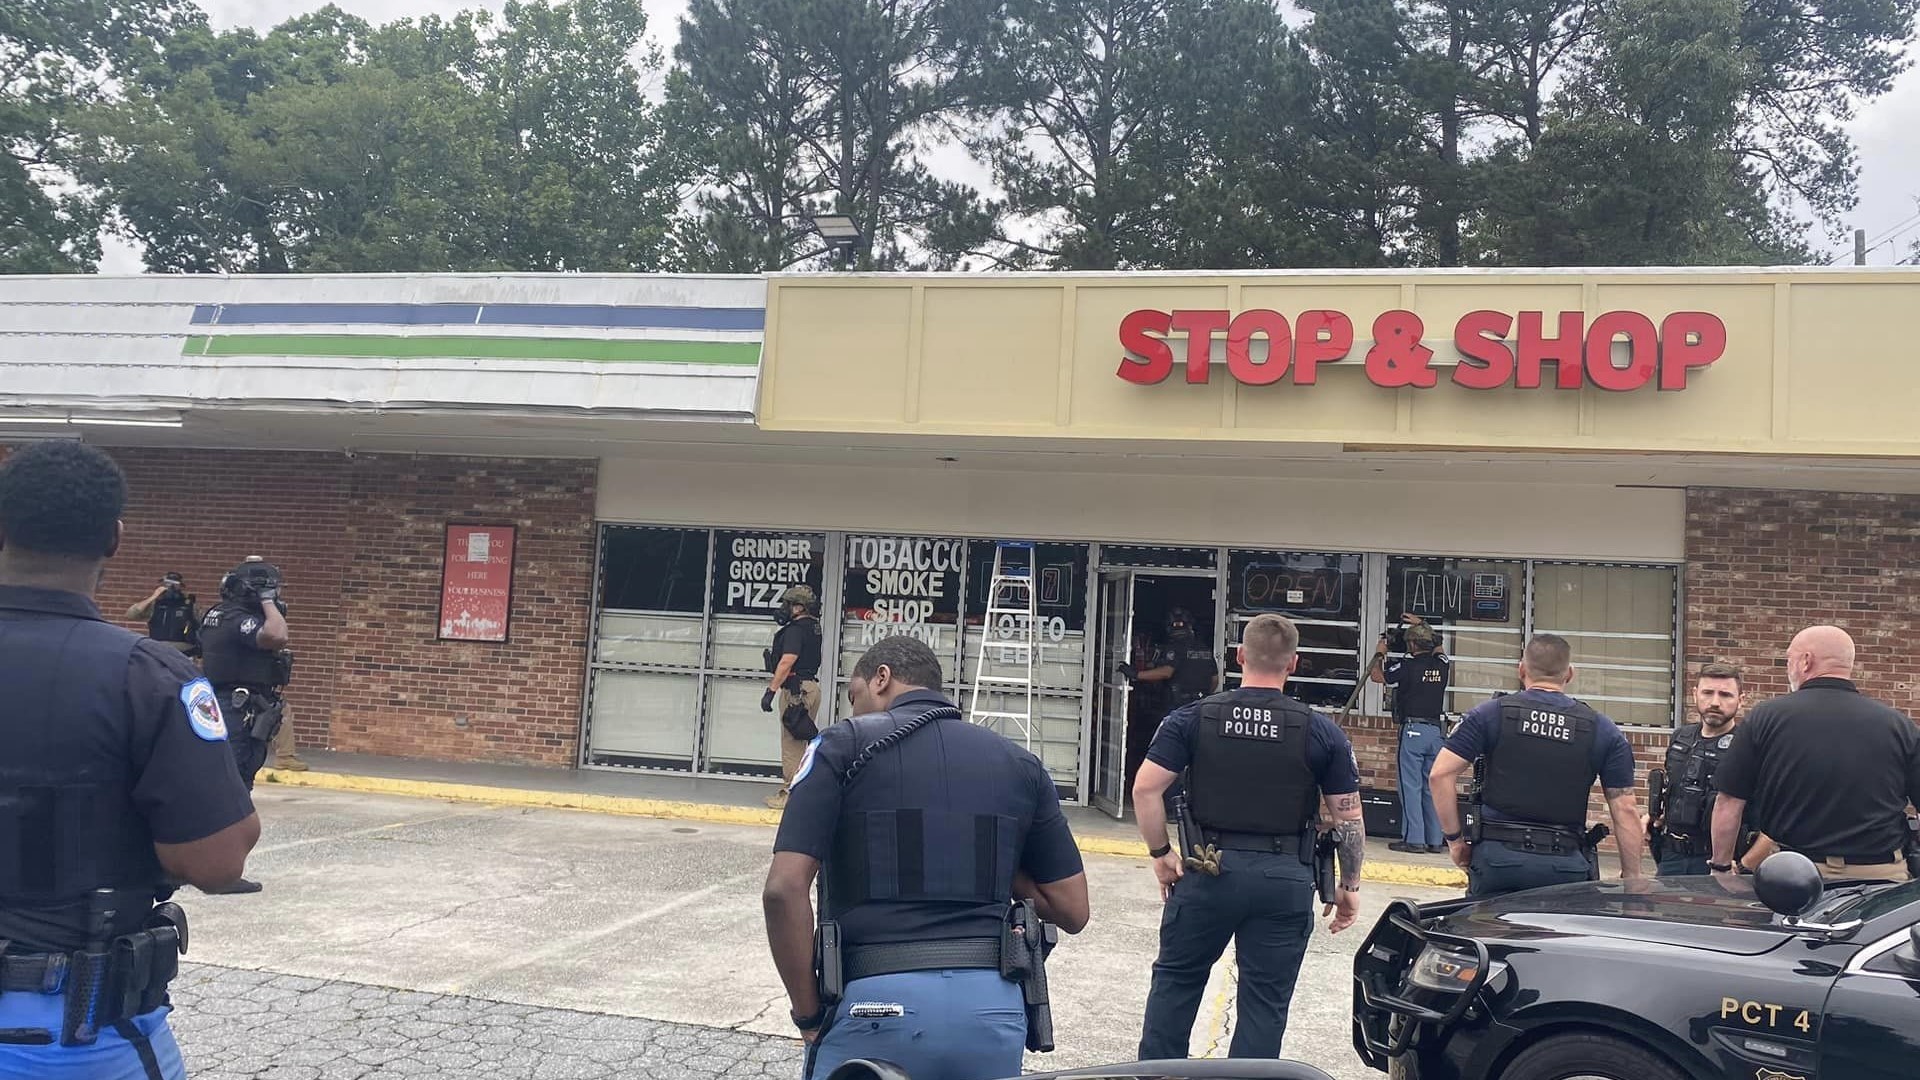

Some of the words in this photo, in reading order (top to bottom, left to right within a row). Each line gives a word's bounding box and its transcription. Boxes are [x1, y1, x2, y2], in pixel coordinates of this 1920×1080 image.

[1116, 309, 1354, 385] STOP
[1365, 310, 1438, 389] &
[1451, 310, 1727, 392] SHOP
[732, 538, 812, 559] GRINDER
[729, 561, 811, 582] GROCERY
[865, 569, 945, 597] SMOKE
[727, 581, 803, 609] PIZZ
[1247, 573, 1341, 604] OPEN
[1412, 574, 1462, 614] ATM
[873, 598, 934, 625] SHOP
[985, 613, 1066, 642] OTTO
[1232, 706, 1272, 722] COBB
[1530, 710, 1566, 726] COBB
[1224, 720, 1279, 738] POLICE
[1522, 721, 1571, 740] POLICE
[1721, 996, 1784, 1027] PCT
[1793, 1010, 1811, 1033] 4
